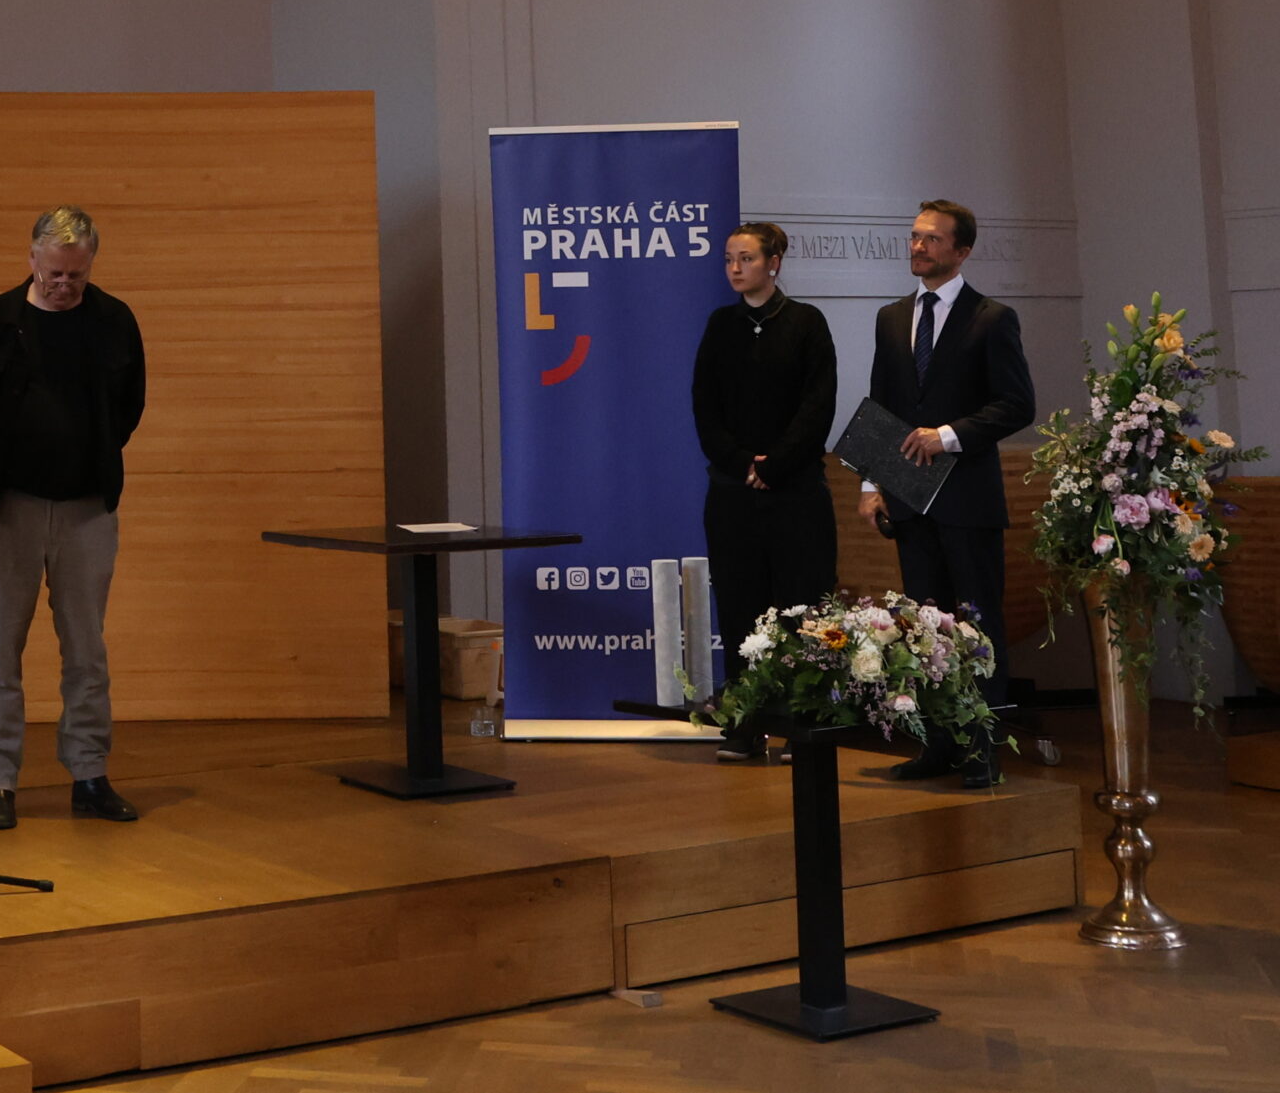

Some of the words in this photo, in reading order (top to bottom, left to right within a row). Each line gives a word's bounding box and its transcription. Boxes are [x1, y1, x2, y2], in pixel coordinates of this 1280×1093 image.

[522, 202, 639, 226] MĚSTSKÁ
[649, 200, 709, 223] ČÁST
[522, 227, 676, 261] PRAHA
[688, 226, 711, 257] 5
[534, 629, 725, 656] www.prahz
